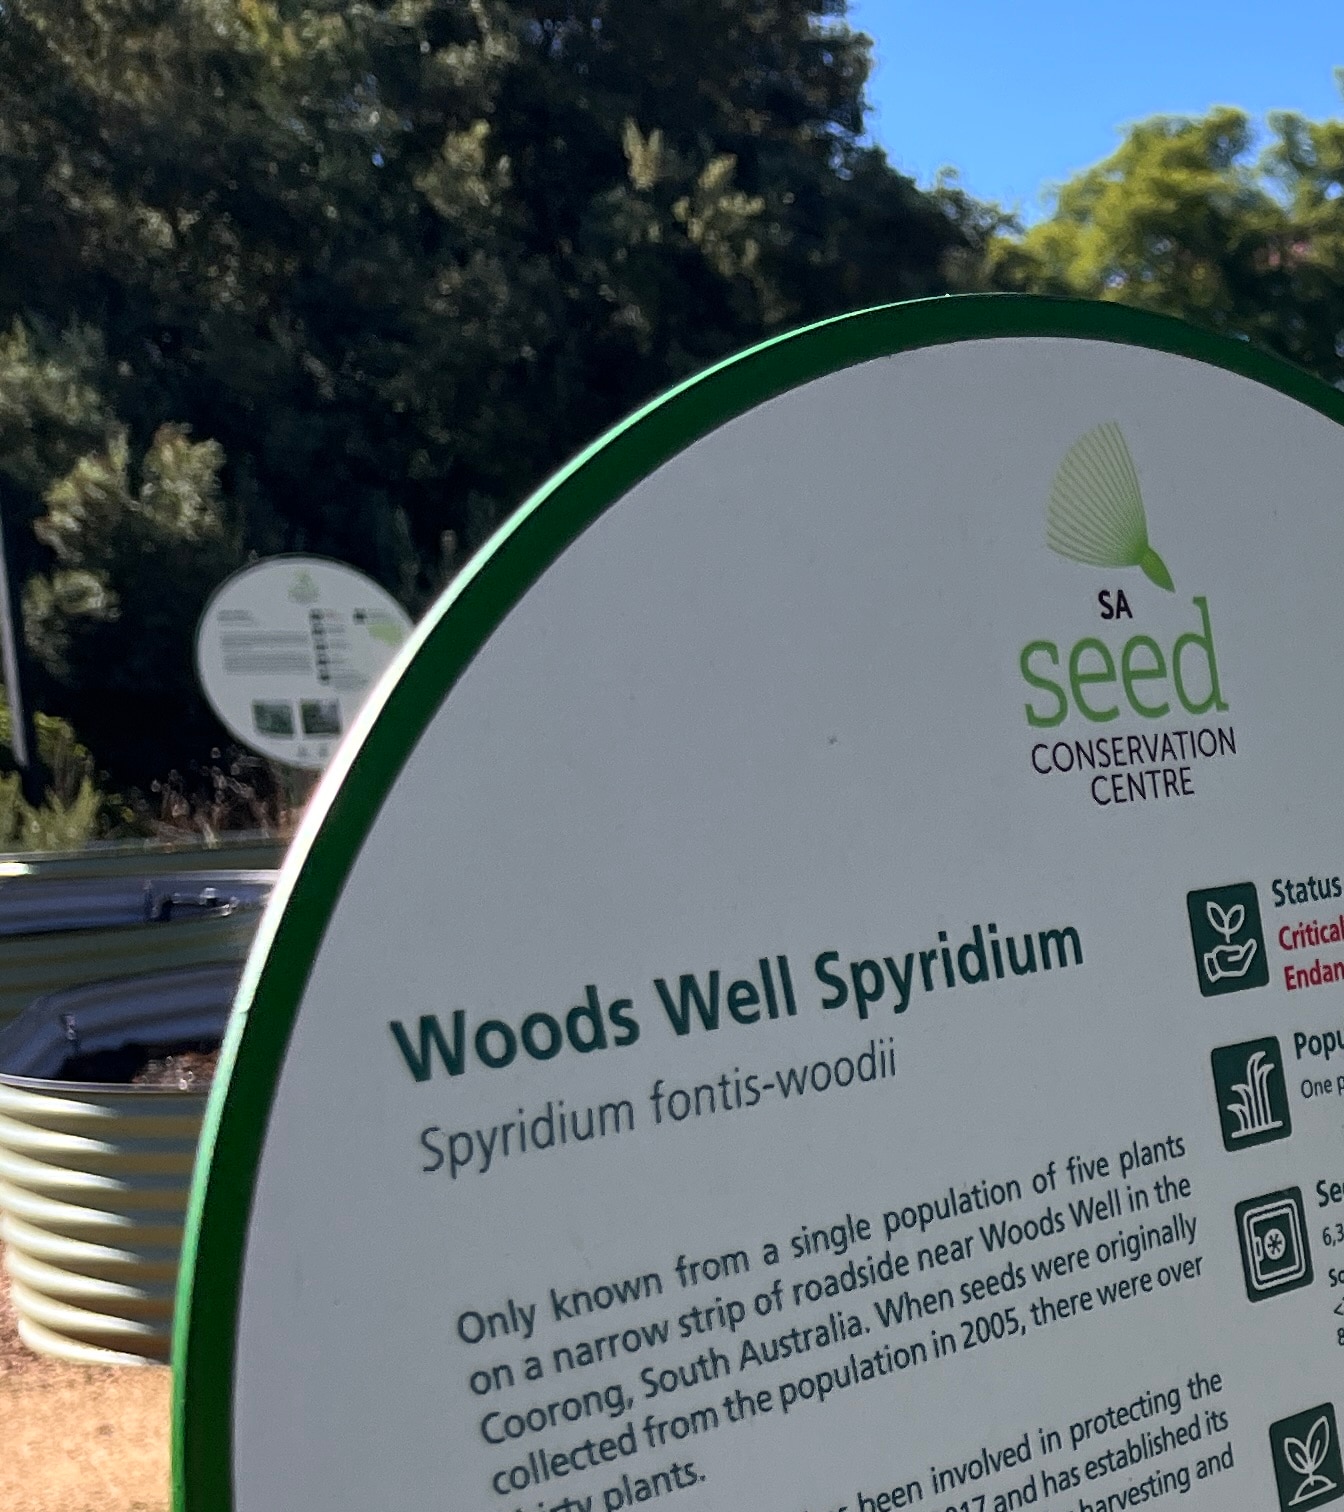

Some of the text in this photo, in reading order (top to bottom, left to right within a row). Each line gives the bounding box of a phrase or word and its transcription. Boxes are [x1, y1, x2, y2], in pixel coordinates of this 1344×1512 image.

[1020, 597, 1229, 728] seed
[1097, 589, 1133, 620] SA
[1031, 726, 1237, 775] CONSERVATION
[1091, 766, 1195, 806] CENTRE
[1271, 875, 1342, 908] Status
[389, 922, 1084, 1083] Woods Well Spyridium
[419, 1037, 896, 1180] Spyridium fontis-woodii
[1300, 1078, 1333, 1099] One
[456, 1135, 1186, 1345] Only known from a single population of five plants
[479, 1212, 1197, 1445] Coorong, South Australia. When seeds were originally
[491, 1256, 1203, 1496] collected from the population in 2005, there were over
[930, 1432, 1032, 1494] involved
[1038, 1427, 1062, 1455] in
[1069, 1387, 1182, 1451] protecting
[1186, 1371, 1222, 1401] the
